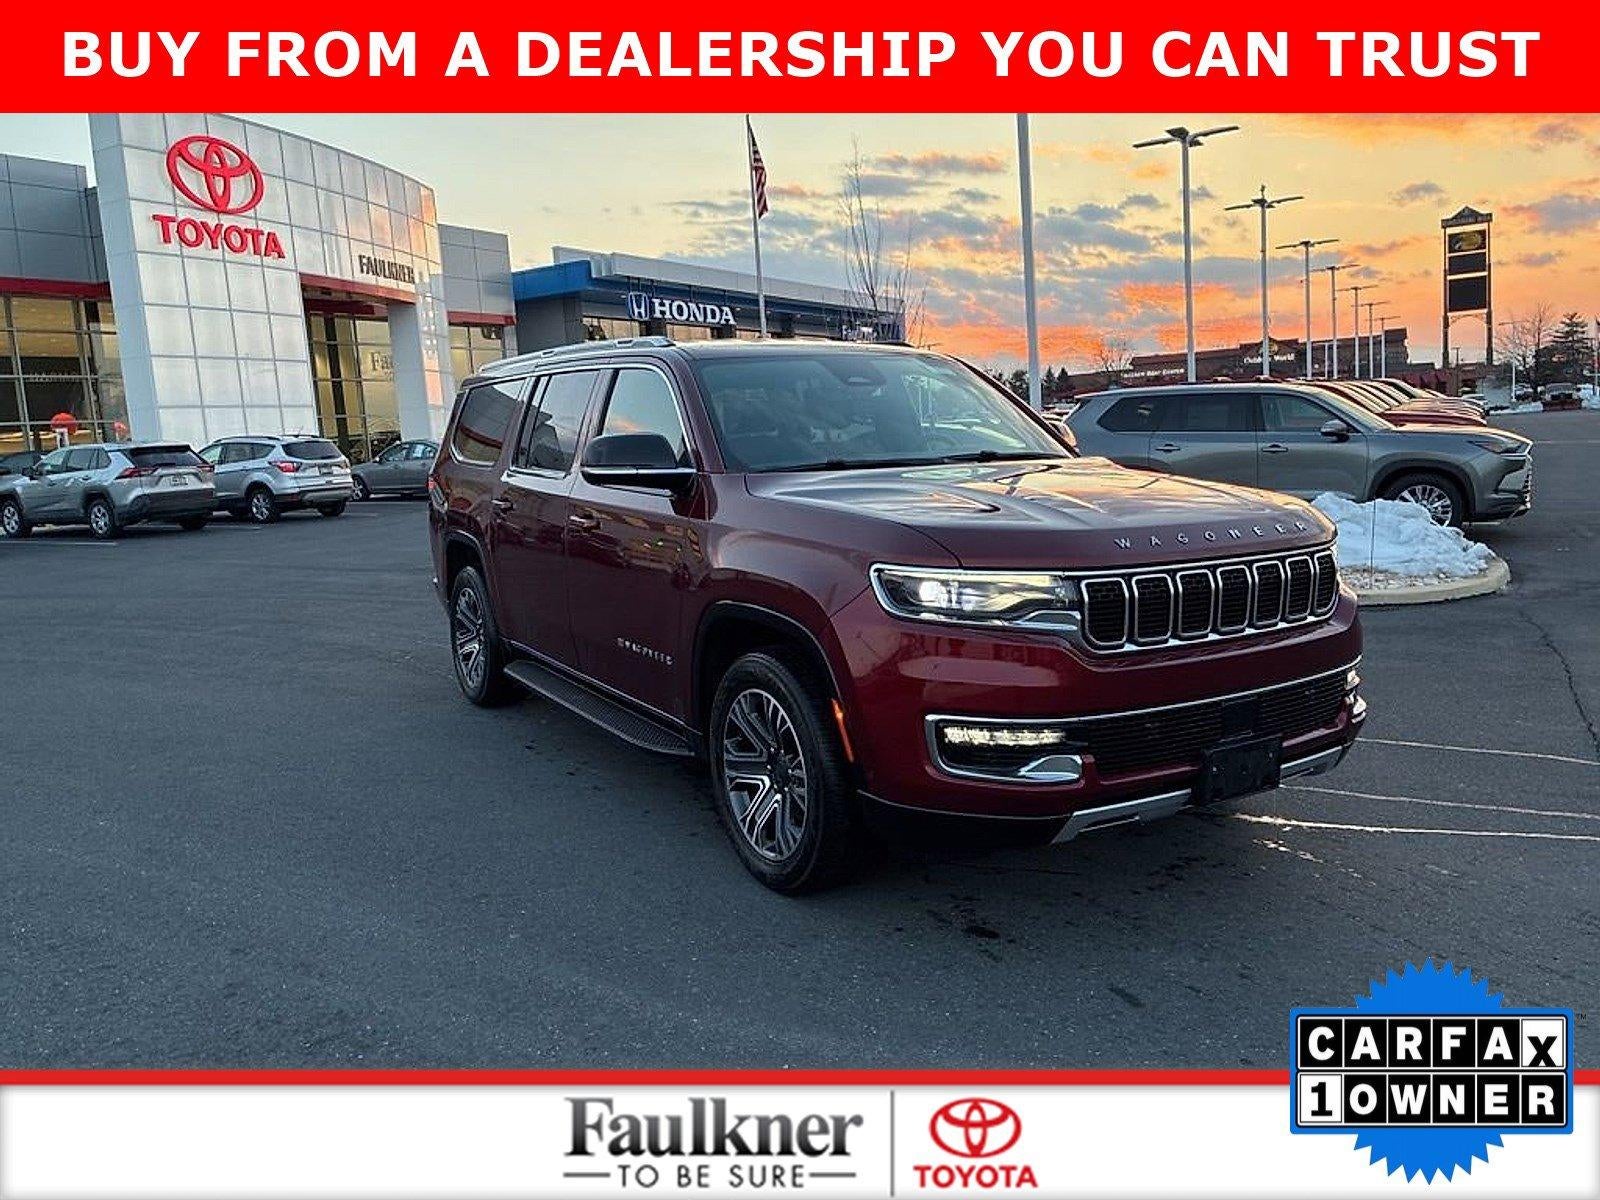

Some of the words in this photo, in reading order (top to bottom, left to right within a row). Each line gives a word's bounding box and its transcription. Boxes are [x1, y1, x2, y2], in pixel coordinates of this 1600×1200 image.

[153, 213, 285, 259] TOYOTA
[358, 254, 415, 284] FAULKNER
[652, 298, 737, 325] HONDA
[1114, 521, 1307, 549] WAGONEER
